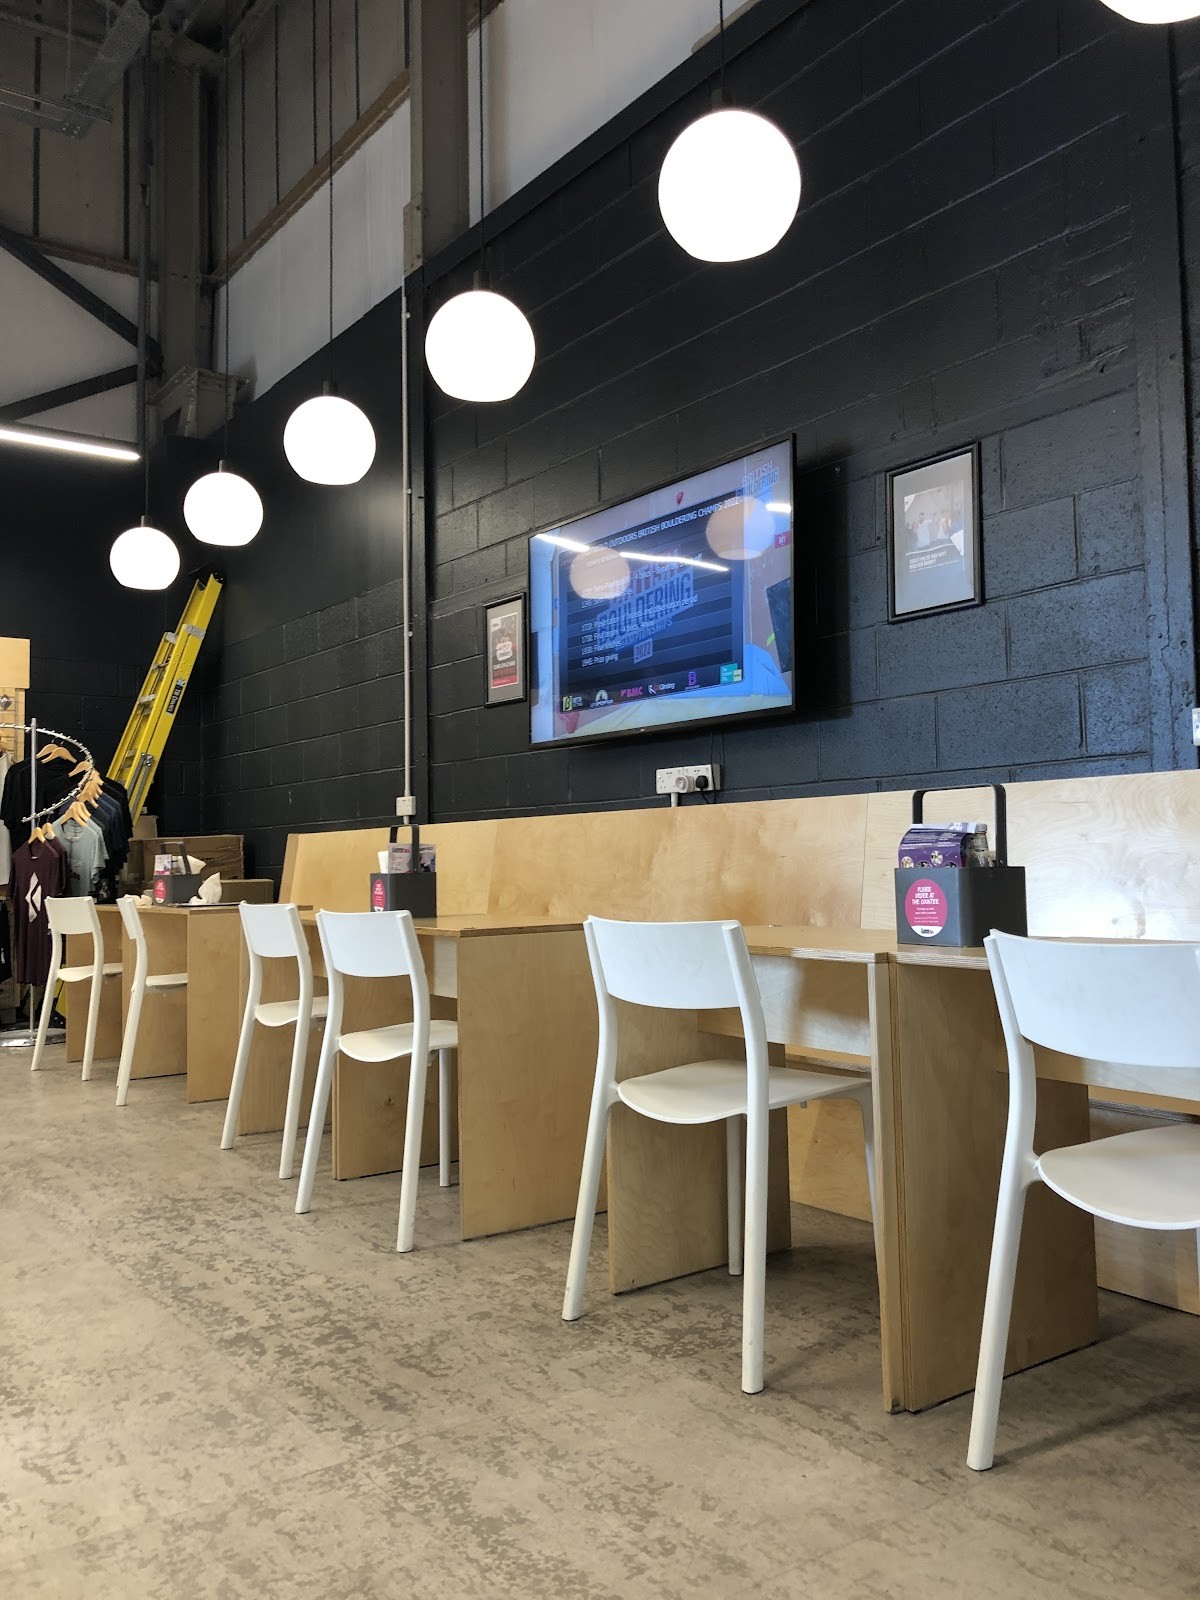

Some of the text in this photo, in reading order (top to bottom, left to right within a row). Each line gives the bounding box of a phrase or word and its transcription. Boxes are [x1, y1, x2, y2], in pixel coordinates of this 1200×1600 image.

[638, 524, 660, 538] BRITISH
[660, 511, 698, 530] BOULDERING
[698, 502, 722, 517] CHAMPS
[626, 686, 642, 698] BMC
